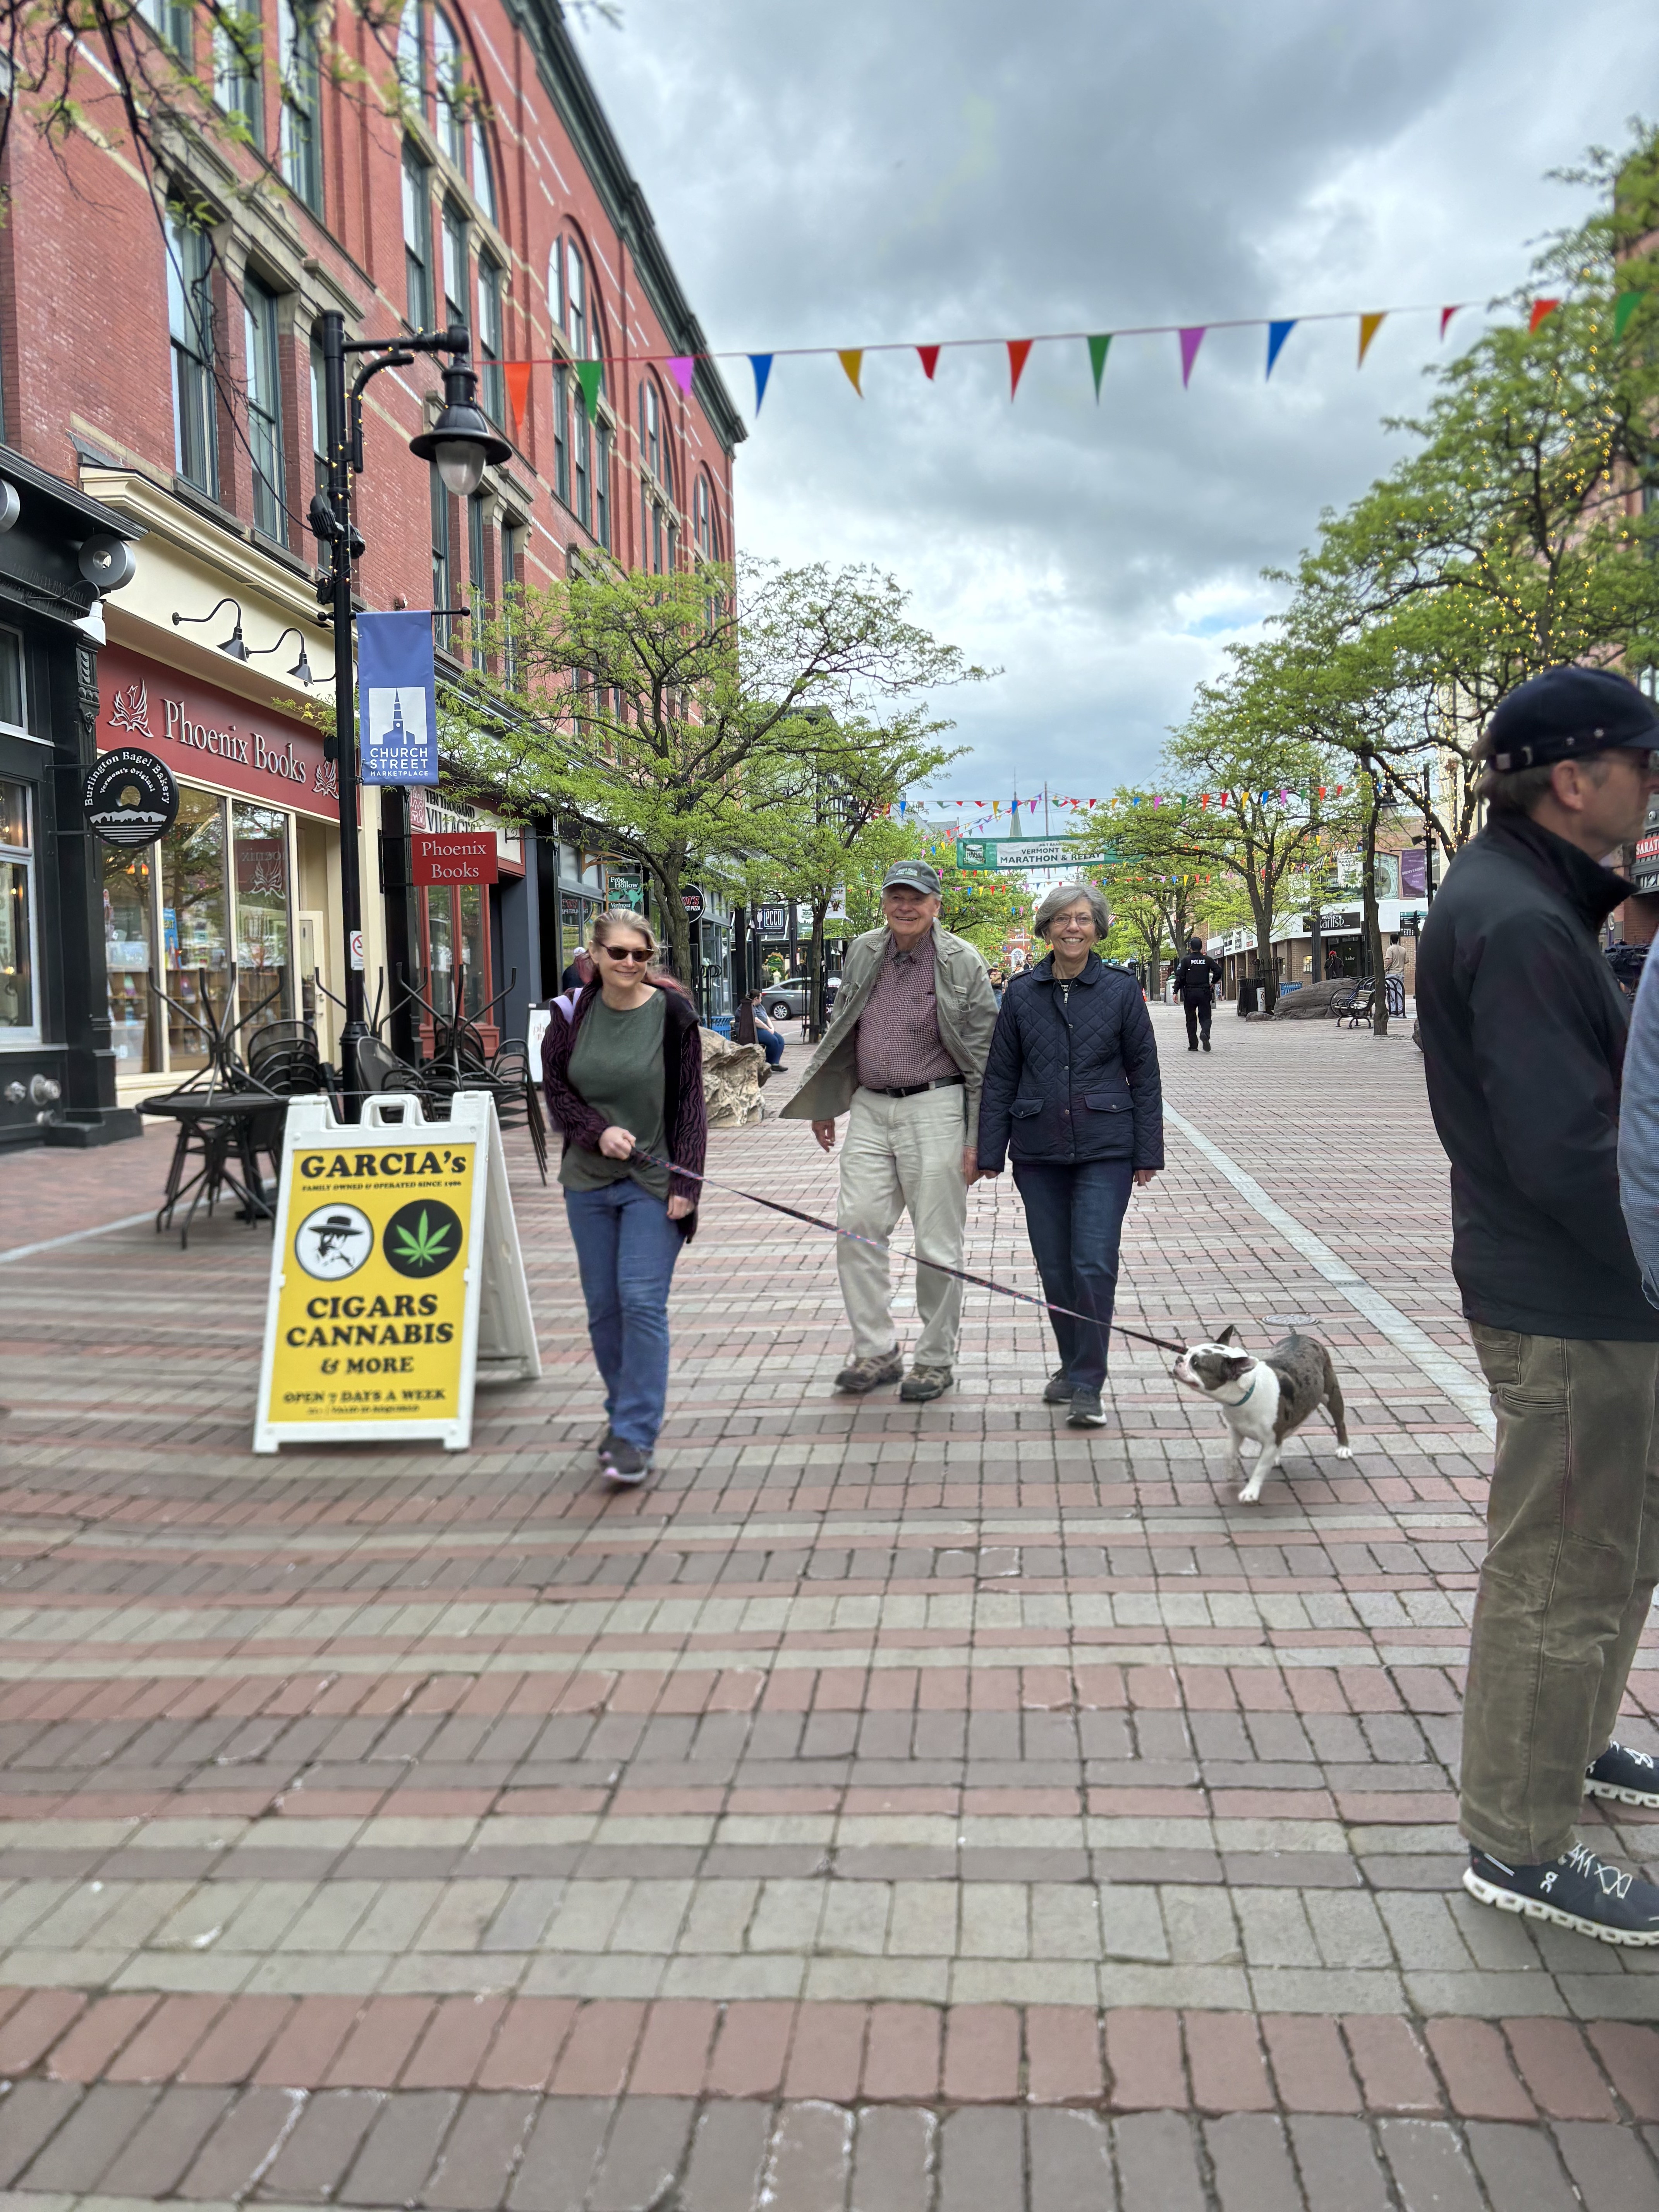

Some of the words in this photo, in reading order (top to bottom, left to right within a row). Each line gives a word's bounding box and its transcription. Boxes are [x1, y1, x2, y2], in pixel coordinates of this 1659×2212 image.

[163, 699, 249, 764] Phoenix
[251, 732, 306, 784] Books
[370, 747, 428, 758] CHURCH
[370, 759, 428, 769] STREET
[85, 756, 119, 806] Burlington
[122, 751, 153, 767] Bagel
[152, 764, 170, 804] Bakery
[100, 768, 128, 794] Vermont's
[130, 768, 156, 792] Original
[424, 788, 439, 806] TEN
[421, 840, 487, 857] Phoenix
[1000, 855, 1058, 864] MARATHON
[431, 862, 479, 879] Books
[301, 1151, 467, 1178] GARCIA's
[306, 1293, 438, 1319] CIGARS
[286, 1322, 454, 1347] CANNABIS
[320, 1358, 339, 1375] &
[347, 1356, 414, 1374] MORE
[283, 1390, 325, 1403] OPEN
[340, 1389, 381, 1402] DAYS
[385, 1390, 397, 1400] A
[401, 1388, 446, 1400] WEEK
